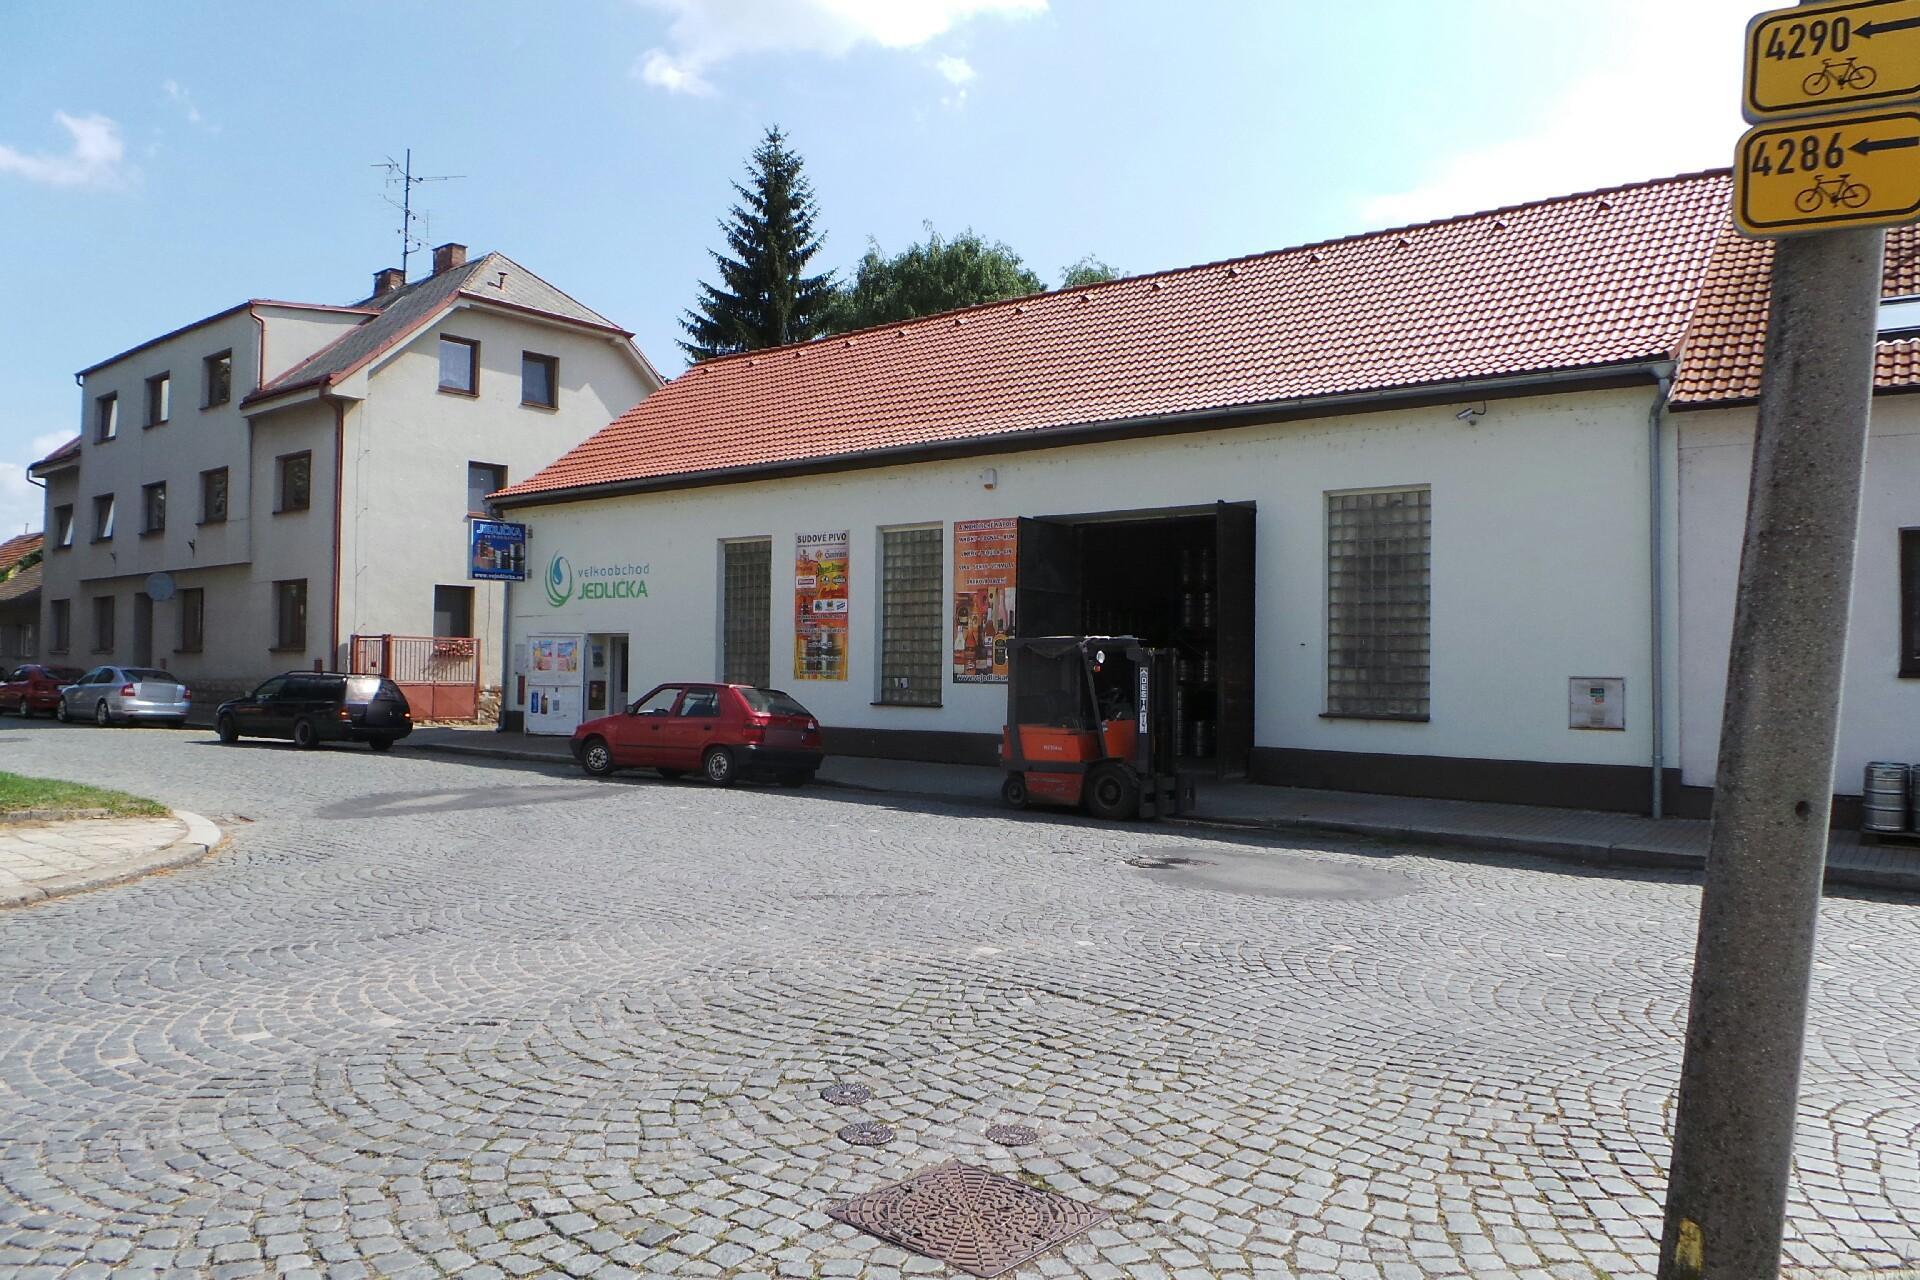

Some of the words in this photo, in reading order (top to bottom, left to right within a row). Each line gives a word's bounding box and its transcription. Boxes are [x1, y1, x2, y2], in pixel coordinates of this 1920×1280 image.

[1765, 16, 1850, 61] 4290
[1751, 132, 1844, 176] 4286
[797, 531, 827, 543] SUDOVÉ
[828, 532, 847, 541] PIVO
[578, 563, 650, 577] velkoobchod
